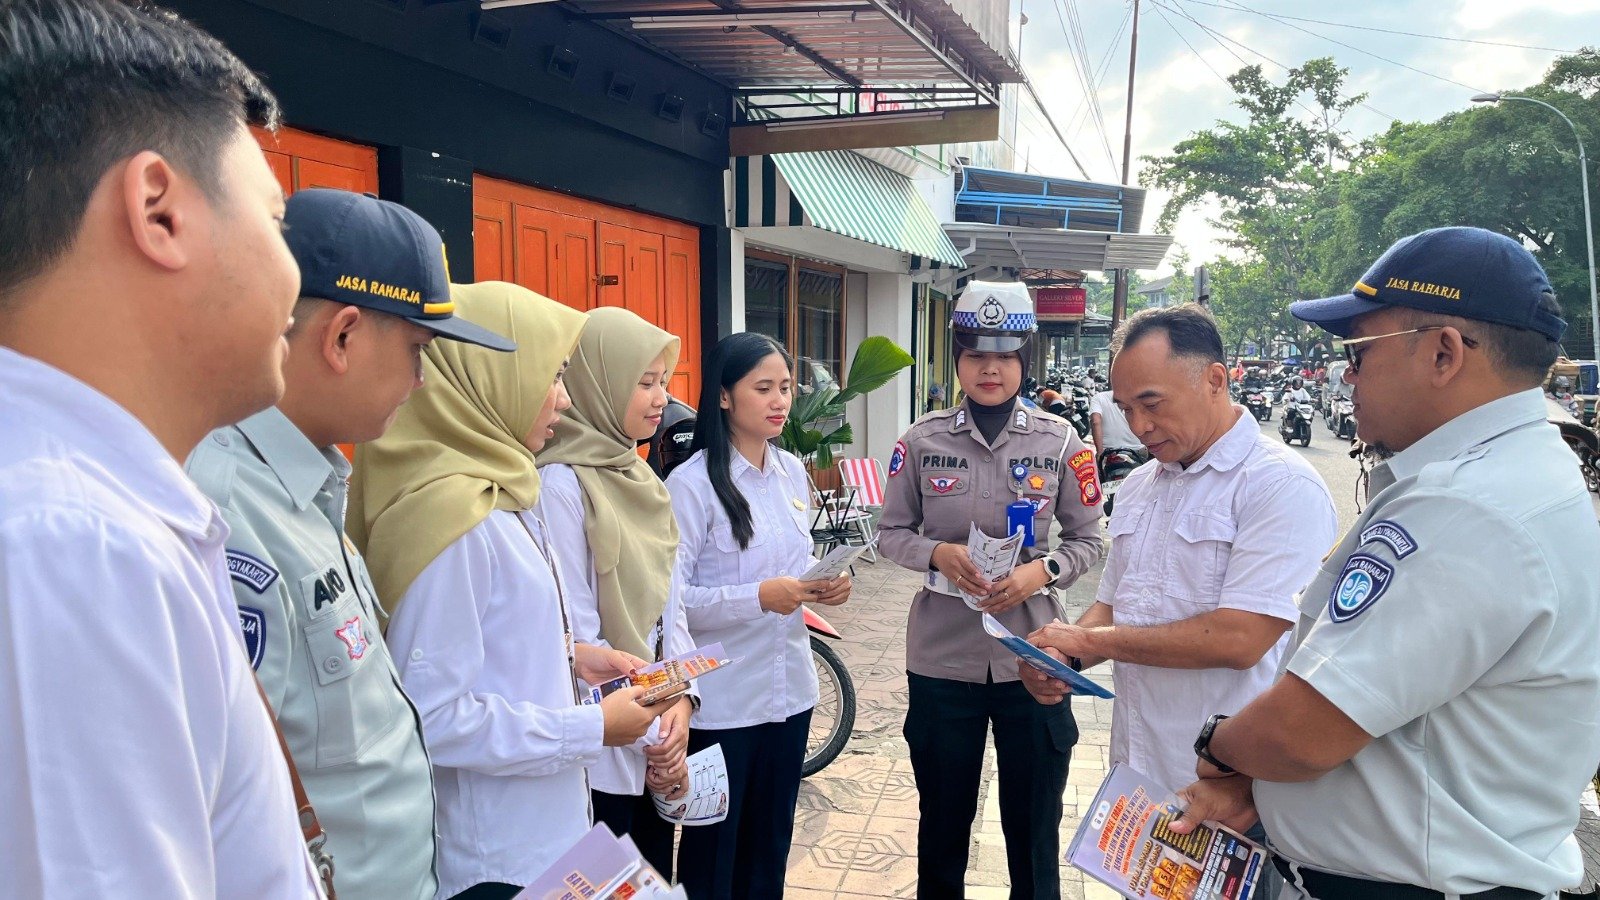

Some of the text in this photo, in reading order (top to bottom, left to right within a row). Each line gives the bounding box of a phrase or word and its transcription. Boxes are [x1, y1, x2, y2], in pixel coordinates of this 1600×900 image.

[336, 275, 421, 304] JASA RAHARJA
[1386, 278, 1461, 300] JASA RAHARJA
[922, 455, 969, 469] PRIMA
[1009, 456, 1059, 472] POLRI
[1360, 561, 1387, 582] RAHARJA
[1098, 818, 1114, 850] DOORPRIZE
[1114, 828, 1131, 871] BERKESEMPATAN
[1128, 811, 1139, 829] DAPAT
[1104, 851, 1112, 871] BAYAR
[1108, 837, 1117, 854] LEBIH
[1114, 823, 1124, 840] AWAL
[566, 873, 595, 900] BAYAR
[1160, 873, 1168, 881] 5
